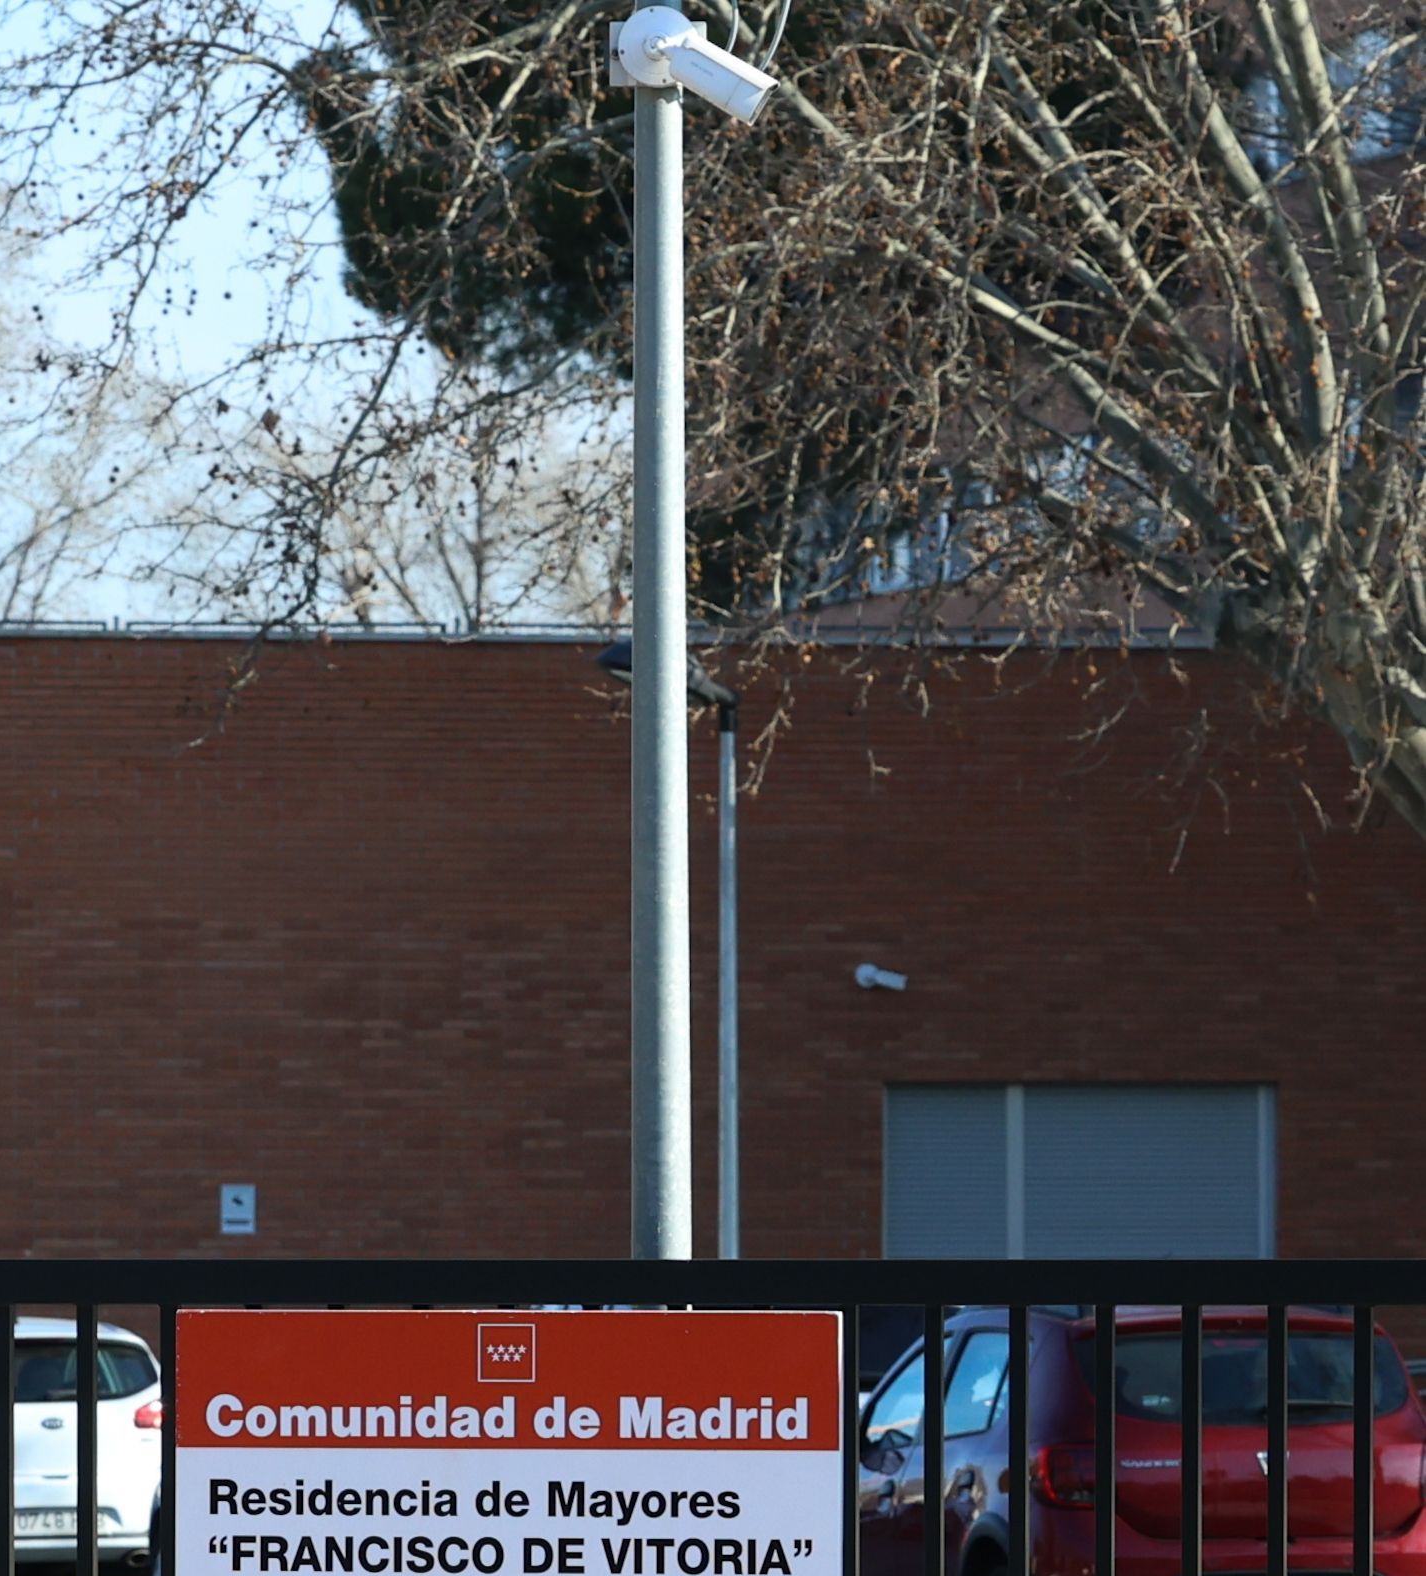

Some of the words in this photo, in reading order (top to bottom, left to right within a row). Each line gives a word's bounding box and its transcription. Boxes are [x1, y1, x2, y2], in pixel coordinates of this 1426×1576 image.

[205, 1393, 516, 1438] Comunidad
[533, 1396, 601, 1439] de
[619, 1396, 809, 1440] Madrid
[208, 1478, 458, 1517] Residencia
[474, 1480, 530, 1518] de
[547, 1480, 741, 1526] Mayores
[209, 1535, 504, 1574] “FRANCISCO
[523, 1537, 586, 1574] DE
[602, 1538, 813, 1576] VITORIA”
